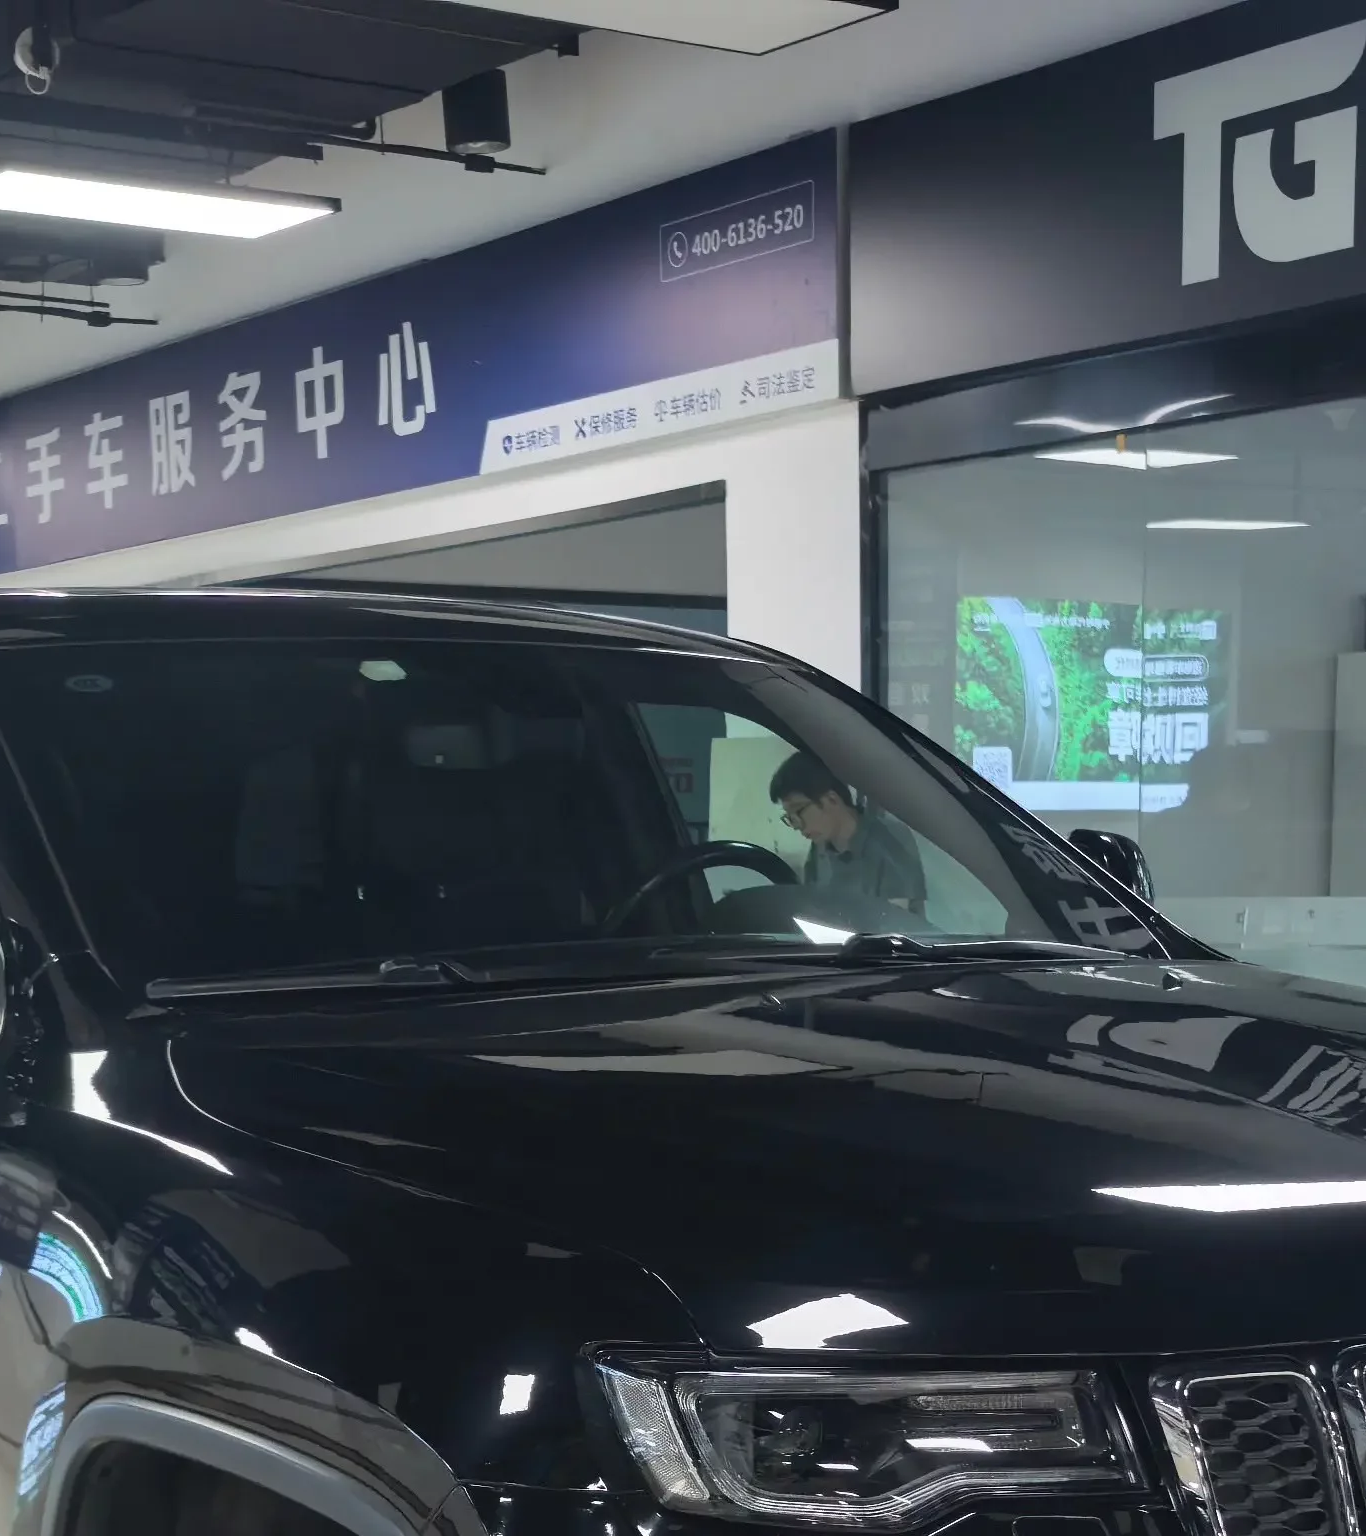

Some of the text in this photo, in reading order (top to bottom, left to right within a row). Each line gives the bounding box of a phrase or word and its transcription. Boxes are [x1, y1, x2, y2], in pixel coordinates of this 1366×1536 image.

[691, 203, 804, 257] 400-6136-520
[588, 407, 638, 438] 保修服务
[669, 387, 722, 421] 车辆估价
[755, 366, 816, 400] 司法鉴定
